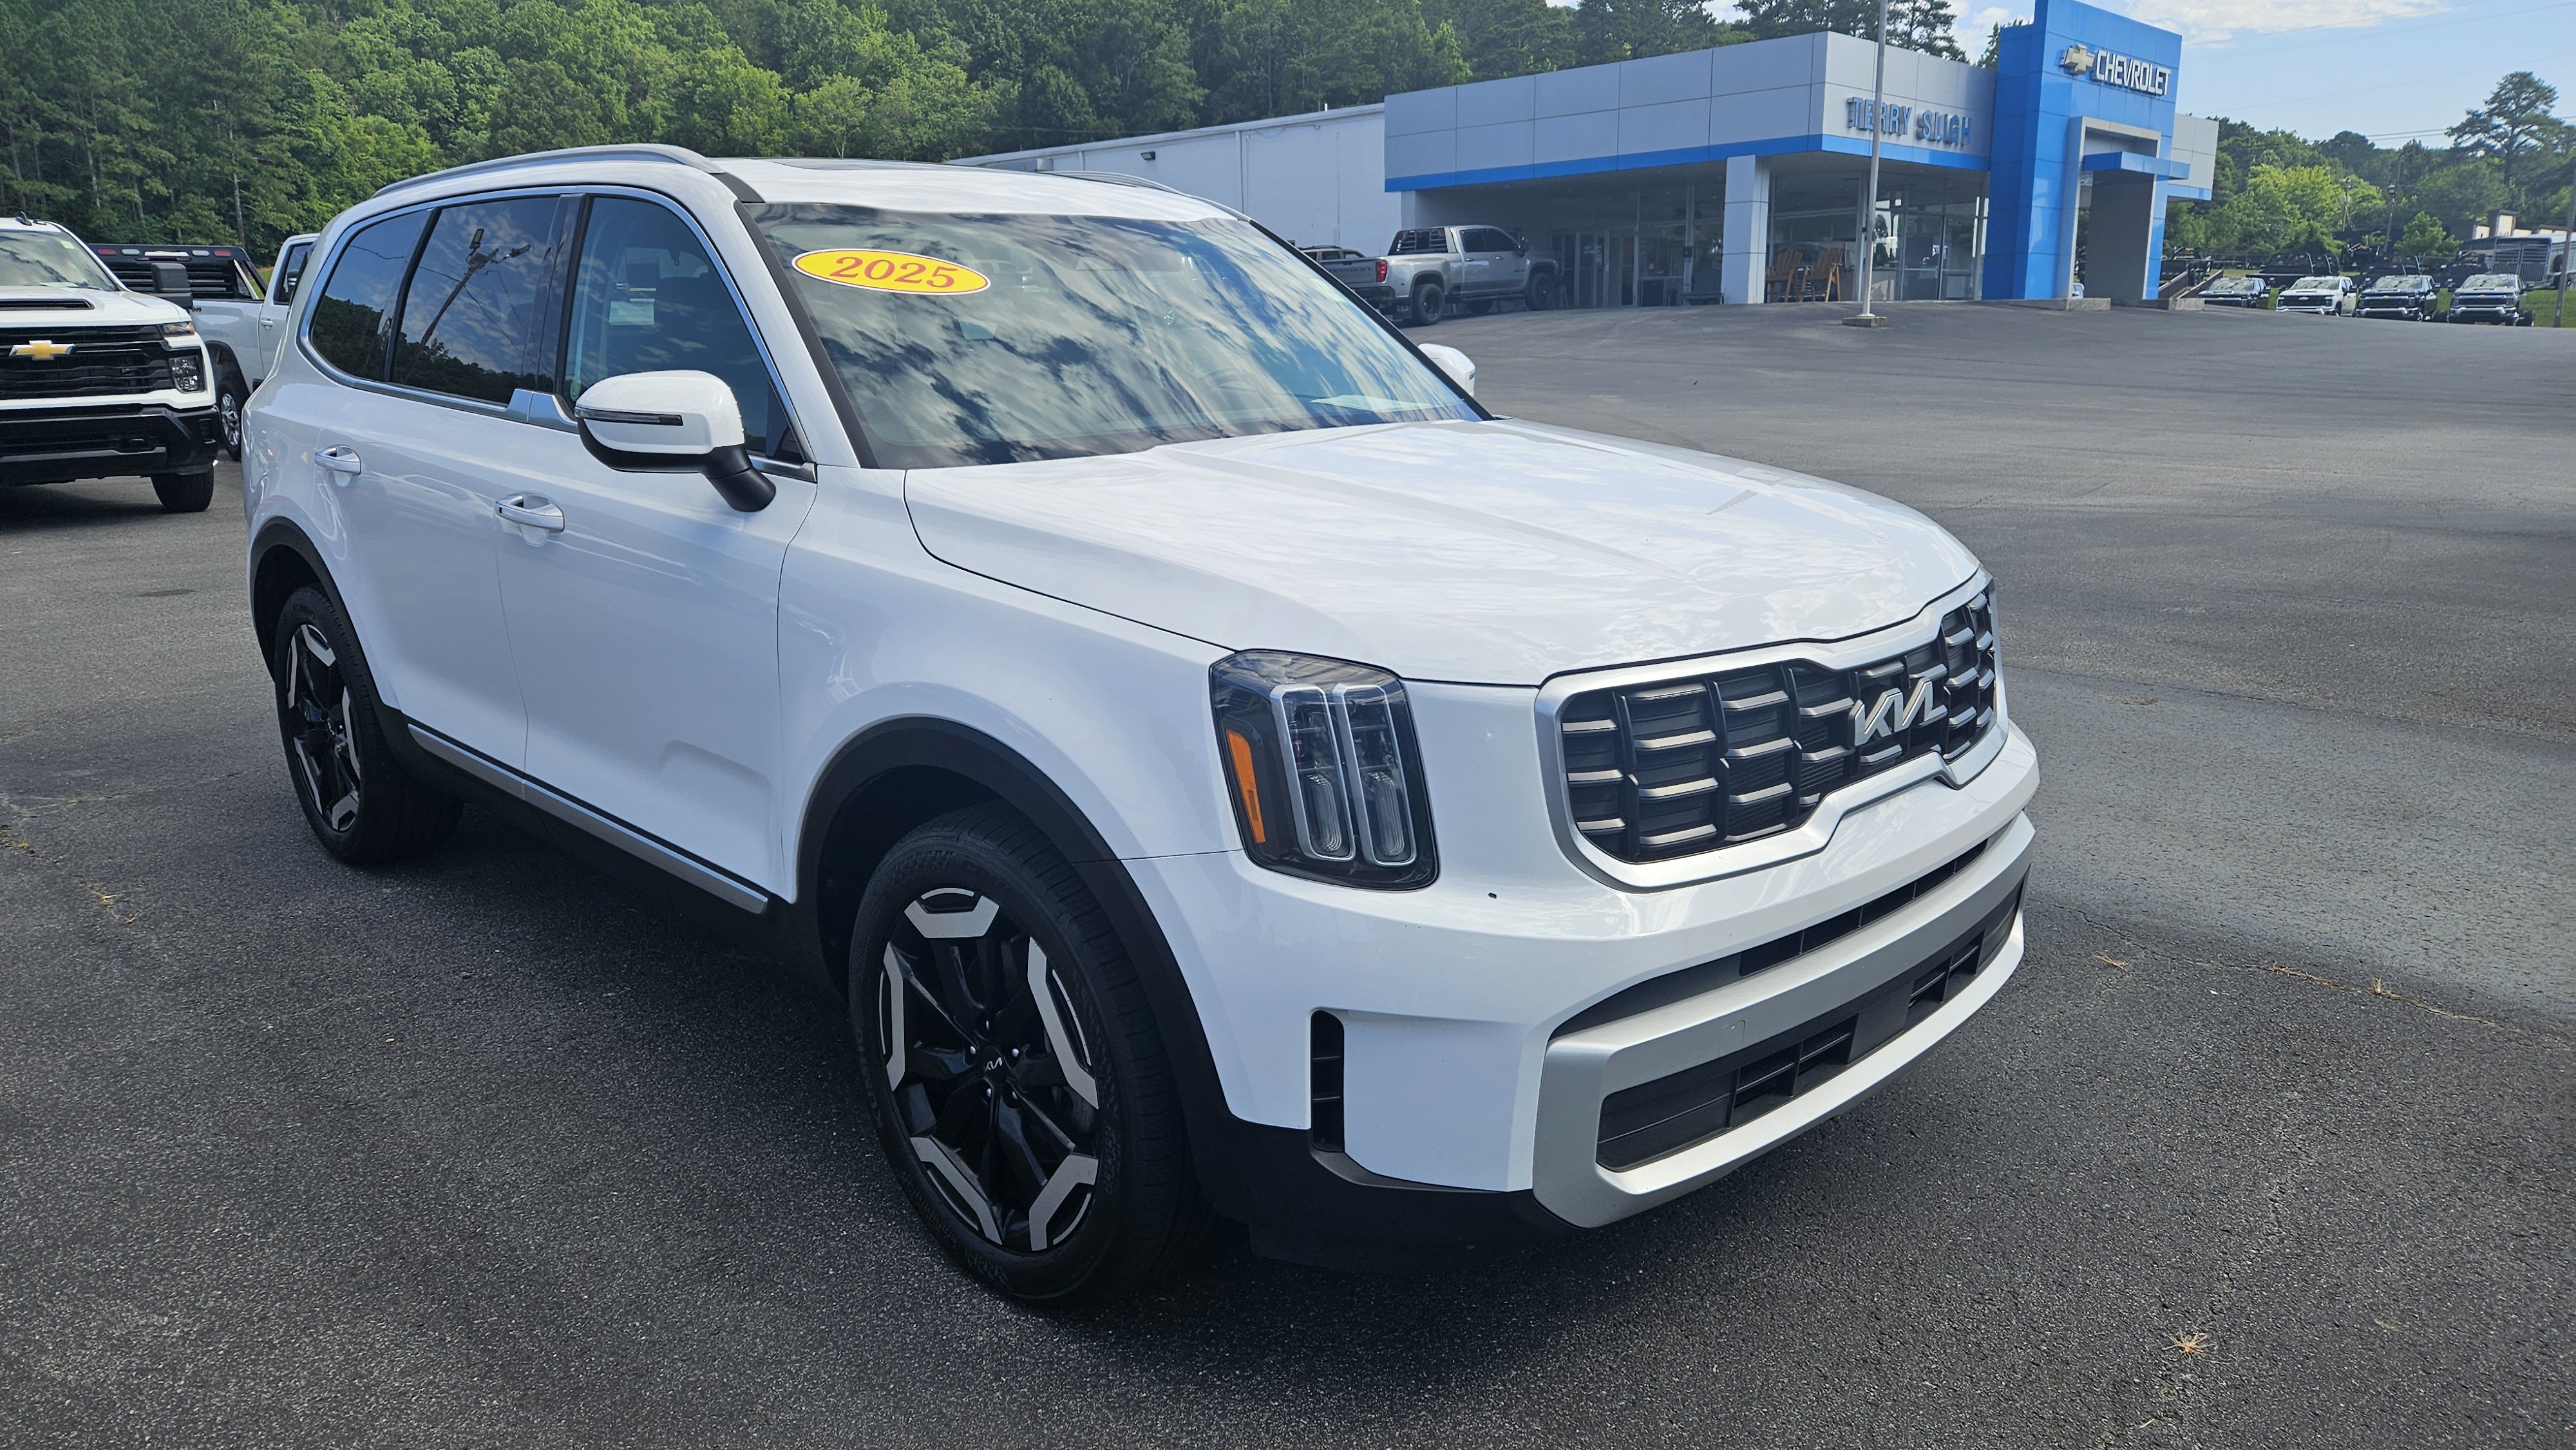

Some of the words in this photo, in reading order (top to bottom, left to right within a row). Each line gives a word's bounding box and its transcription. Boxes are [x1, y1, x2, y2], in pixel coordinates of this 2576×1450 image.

[2096, 50, 2172, 96] CHEVROLET
[1847, 97, 1913, 135] TERRY
[1919, 109, 1971, 145] SLIGH
[829, 256, 958, 288] 2025
[1848, 677, 1933, 747] KIA
